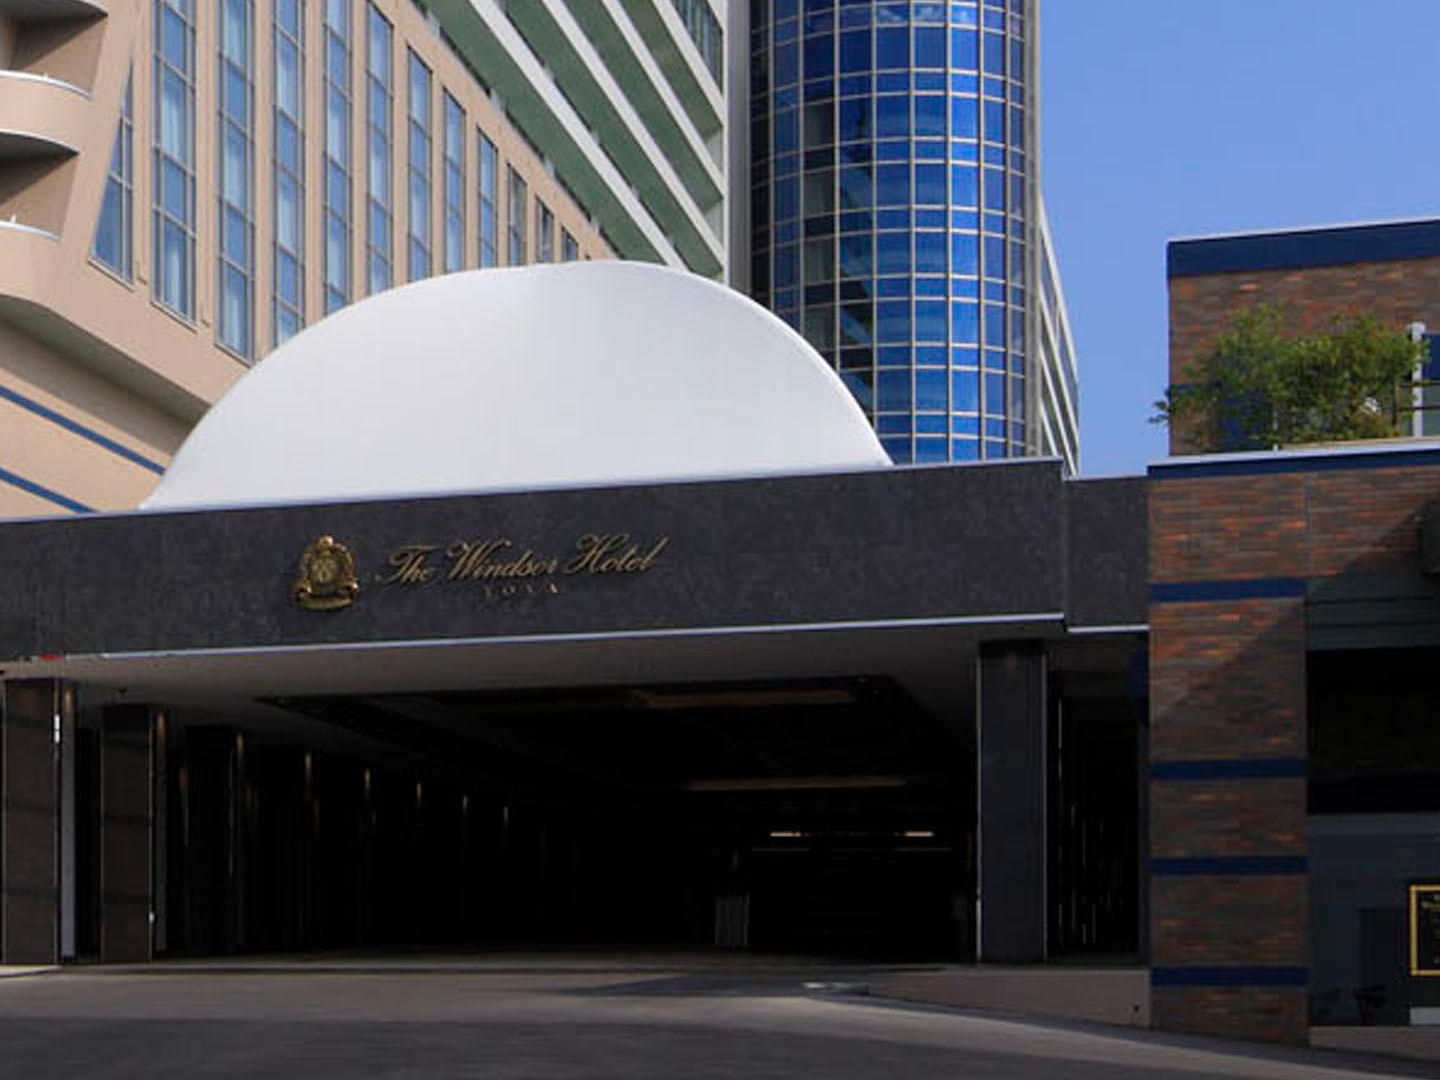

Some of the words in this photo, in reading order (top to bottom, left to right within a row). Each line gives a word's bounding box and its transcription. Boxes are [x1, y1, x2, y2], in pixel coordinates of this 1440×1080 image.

[381, 544, 440, 588] The
[445, 538, 558, 580] Windsor
[561, 532, 669, 574] Hotel
